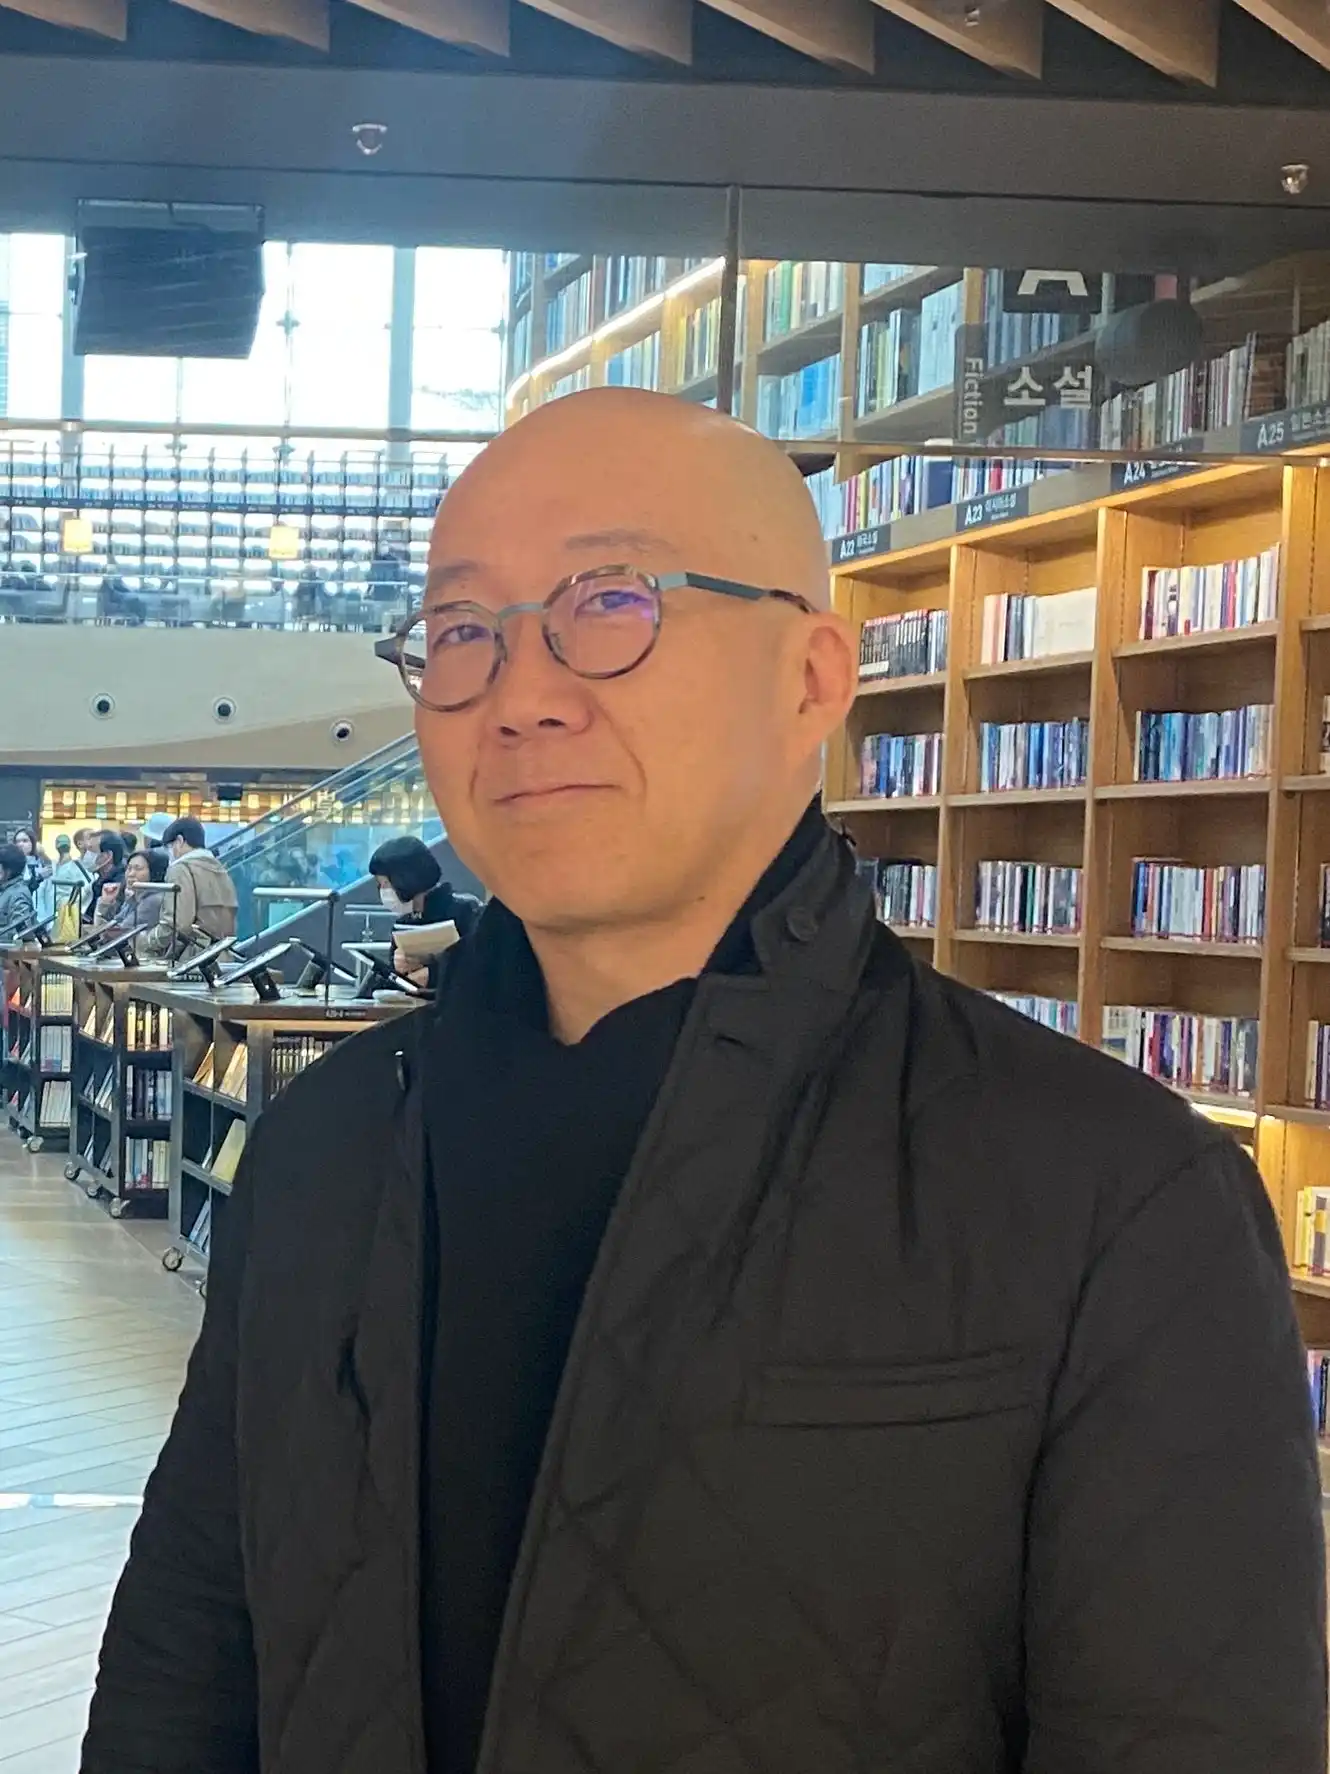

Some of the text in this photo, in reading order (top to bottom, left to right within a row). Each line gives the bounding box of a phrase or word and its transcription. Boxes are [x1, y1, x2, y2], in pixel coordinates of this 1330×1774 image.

[963, 356, 984, 434] Fiction
[1003, 365, 1092, 409] 소설
[1257, 421, 1285, 449] A25
[1123, 460, 1146, 486] A24
[964, 503, 983, 526] A23
[840, 539, 855, 560] A22
